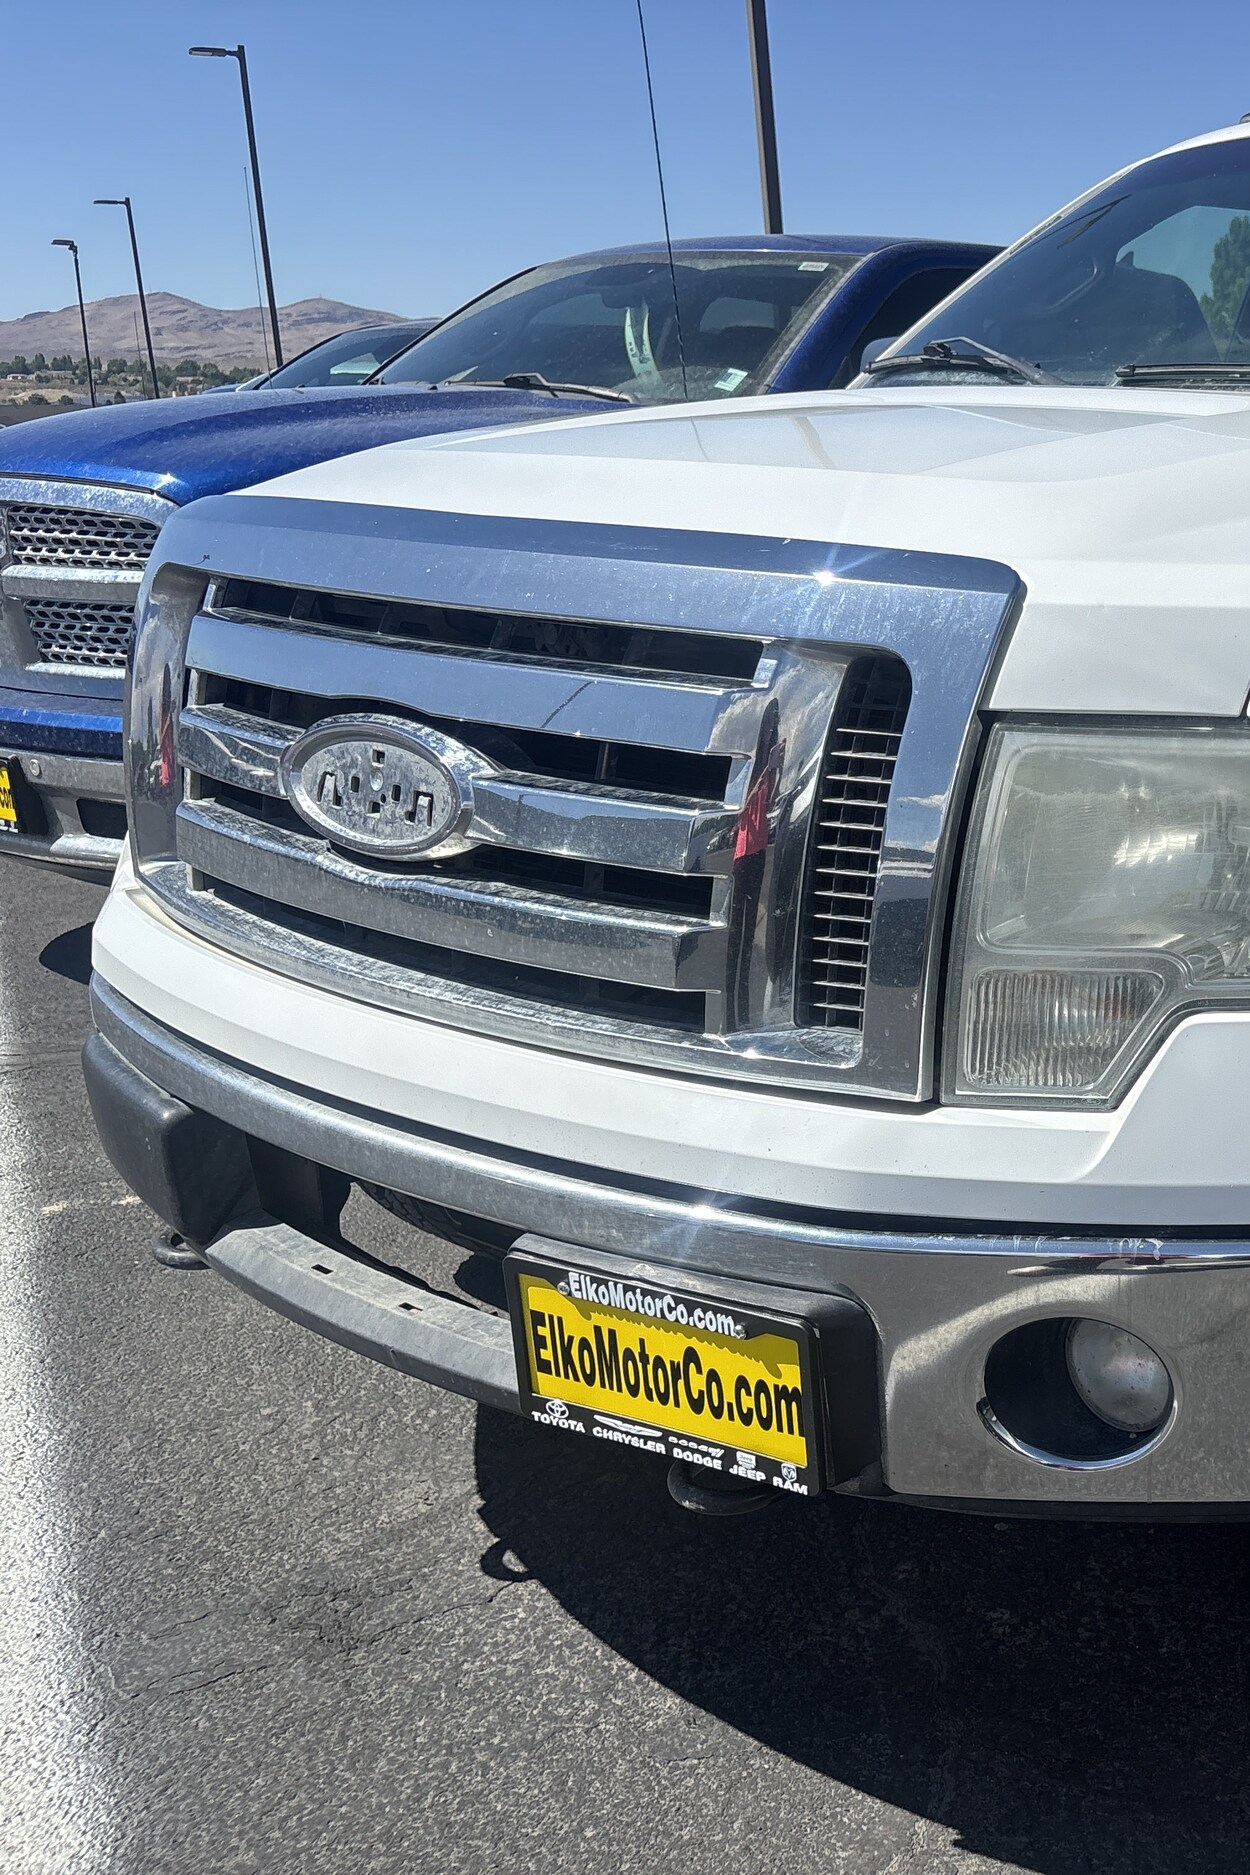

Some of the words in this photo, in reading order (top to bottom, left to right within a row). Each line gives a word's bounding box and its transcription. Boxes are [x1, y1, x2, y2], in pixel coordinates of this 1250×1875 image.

[568, 1271, 735, 1335] ElkoMotorCo.com
[530, 1309, 804, 1437] ElkoMotorCo.com
[531, 1411, 586, 1433] TOYOTA
[592, 1426, 666, 1454] CHRYSLER
[673, 1448, 722, 1470] DODGE
[729, 1464, 766, 1481] JEEP
[773, 1476, 808, 1495] RAM
